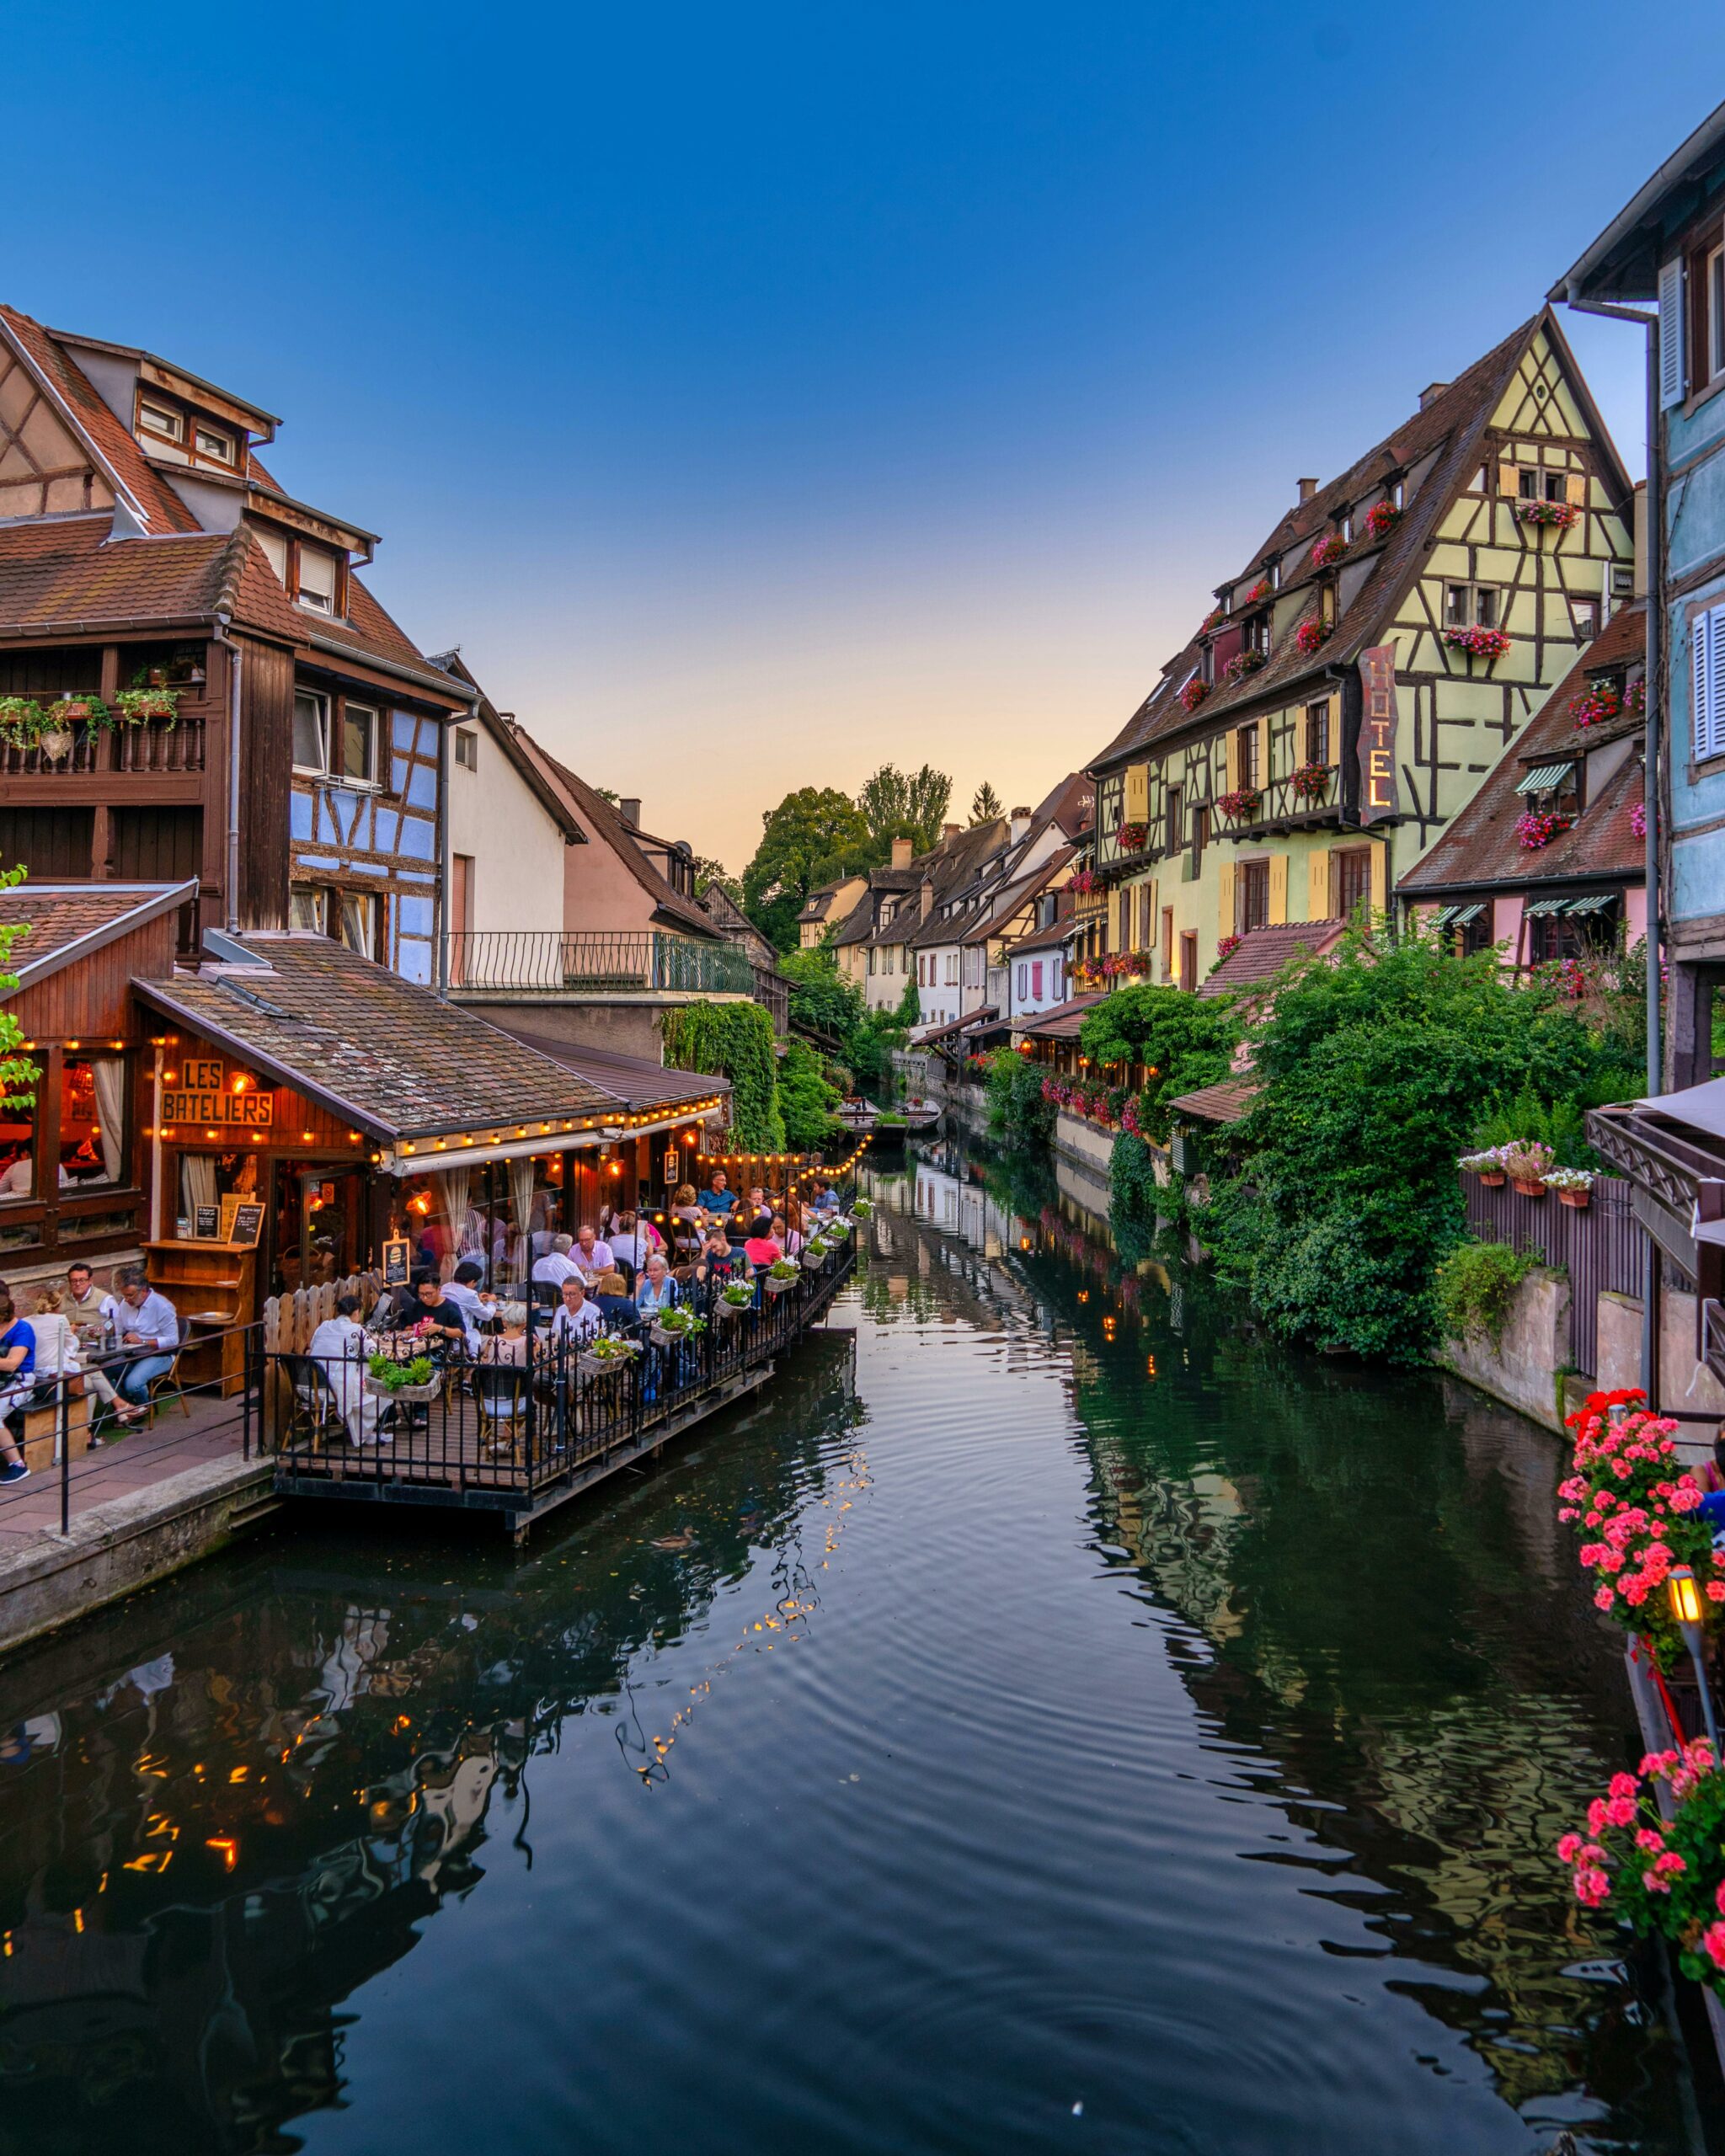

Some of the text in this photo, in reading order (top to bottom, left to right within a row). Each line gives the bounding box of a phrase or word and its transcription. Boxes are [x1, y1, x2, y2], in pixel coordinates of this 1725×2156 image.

[1370, 661, 1391, 807] HOTEL
[185, 1063, 221, 1089] LES
[163, 1093, 270, 1123] BATELIERS
